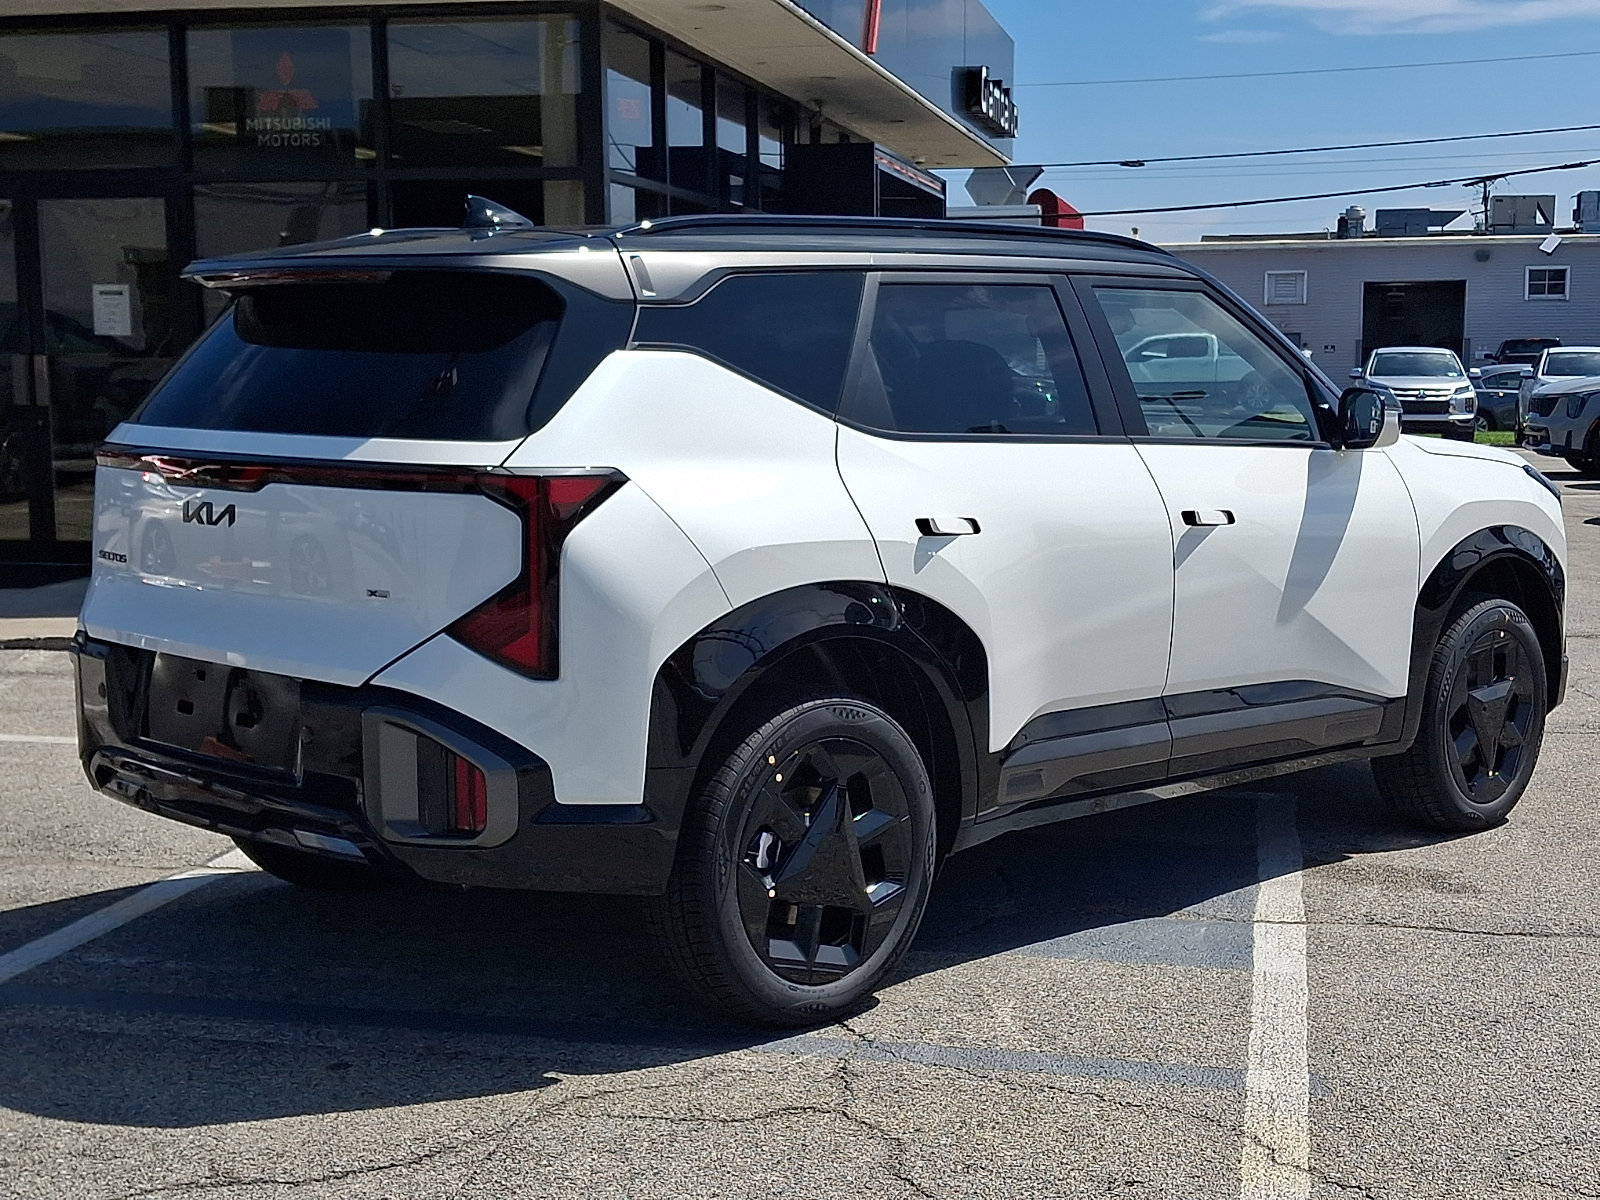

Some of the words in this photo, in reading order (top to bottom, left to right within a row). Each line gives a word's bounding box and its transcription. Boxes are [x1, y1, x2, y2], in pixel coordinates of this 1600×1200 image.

[246, 117, 331, 130] MITSUBISHI
[258, 133, 320, 147] MOTORS
[183, 500, 236, 528] KIA
[99, 550, 127, 563] SELTOS
